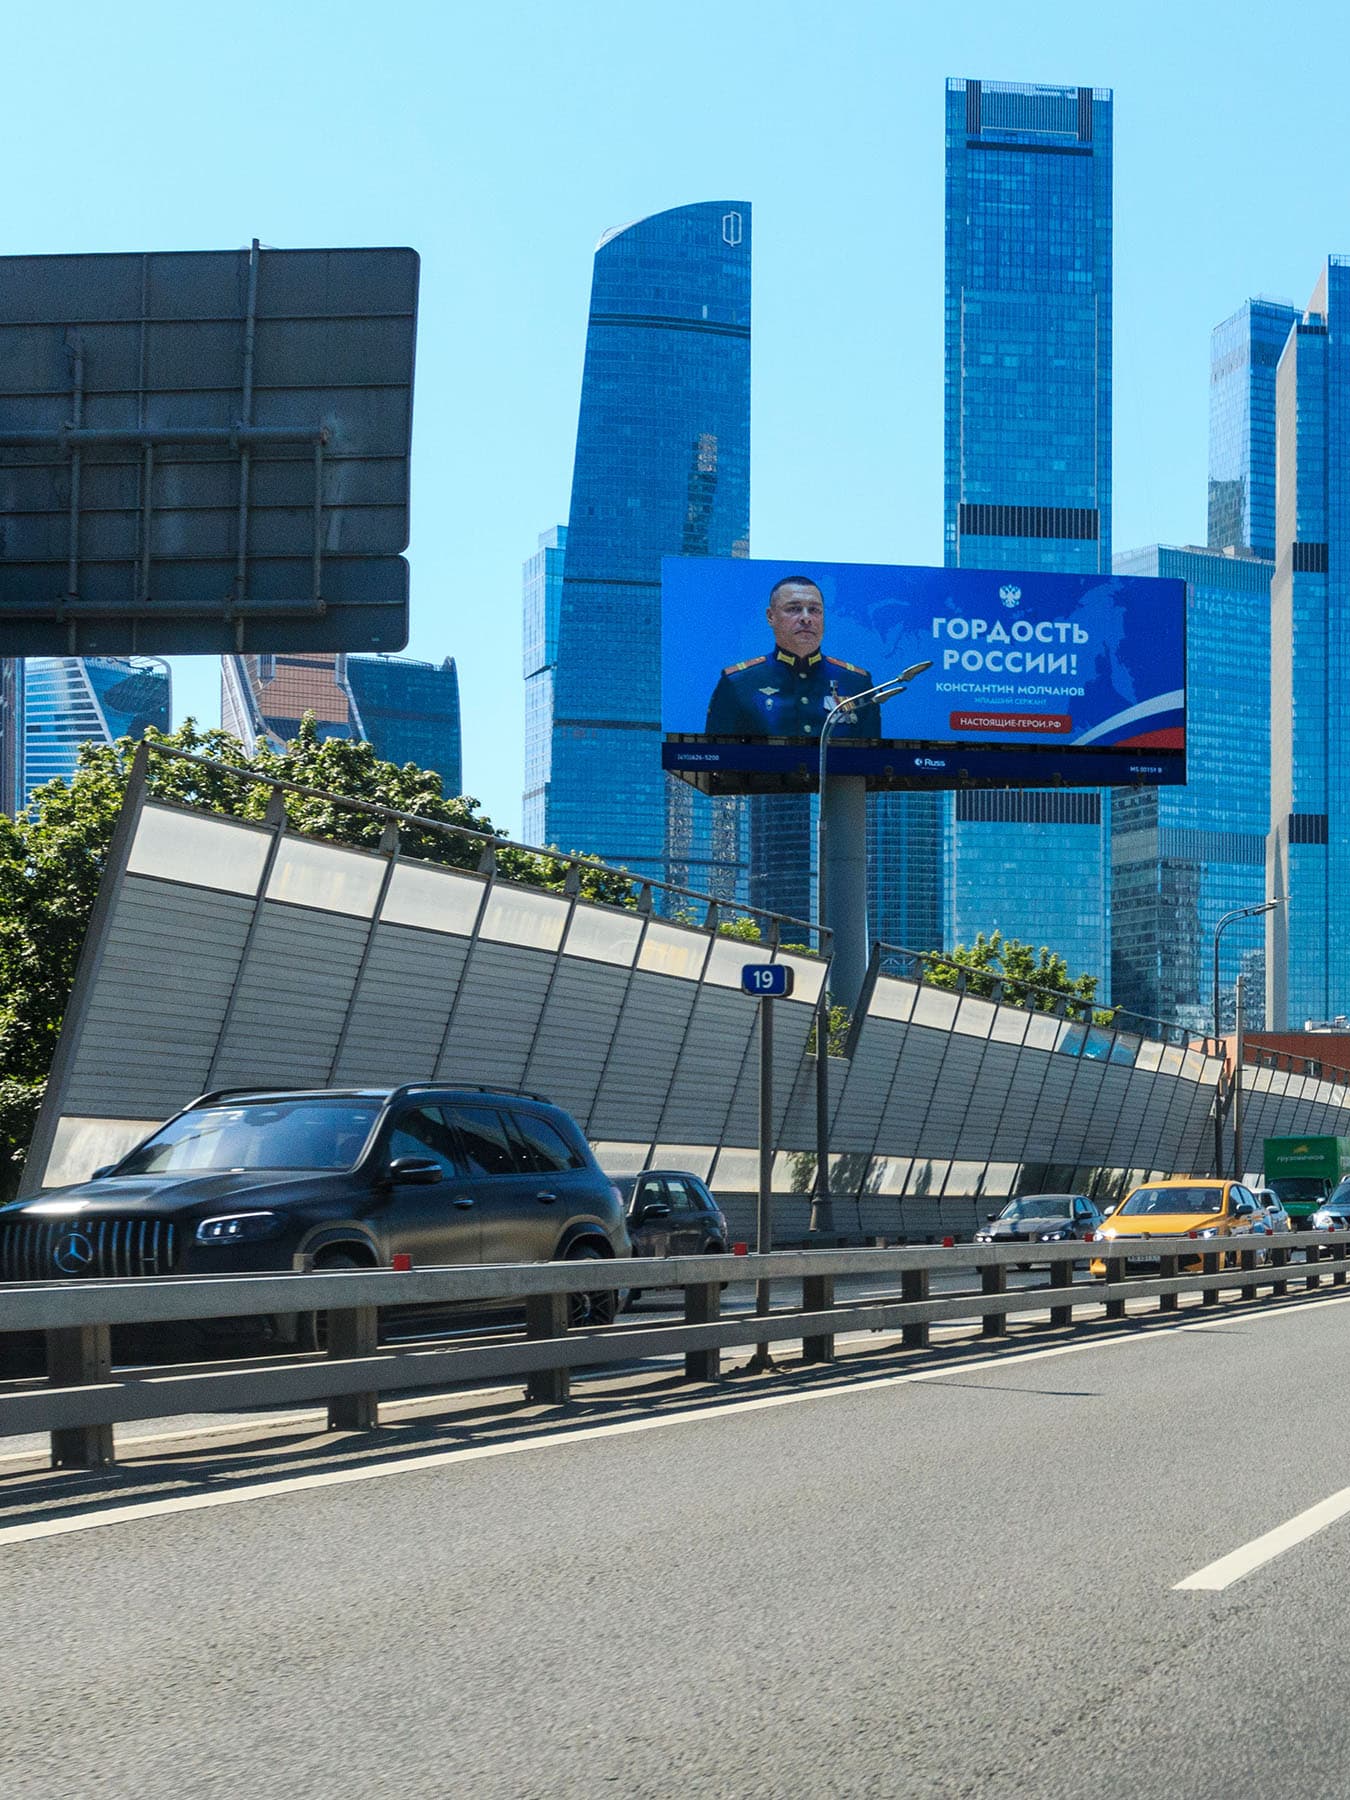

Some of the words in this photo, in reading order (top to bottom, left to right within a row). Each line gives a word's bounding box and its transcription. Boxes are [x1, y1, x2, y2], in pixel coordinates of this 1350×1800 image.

[932, 617, 1089, 644] ГОРДОСТЬ
[943, 649, 1077, 675] РОССИИ!
[935, 682, 1014, 694] КОНСТАНТИН
[1017, 685, 1085, 697] МОЛЧАНОВ
[960, 717, 1061, 729] НАСТОЯЩИЕ-ГЕРОИ.РФ
[924, 758, 946, 767] Russ
[753, 970, 774, 988] 19
